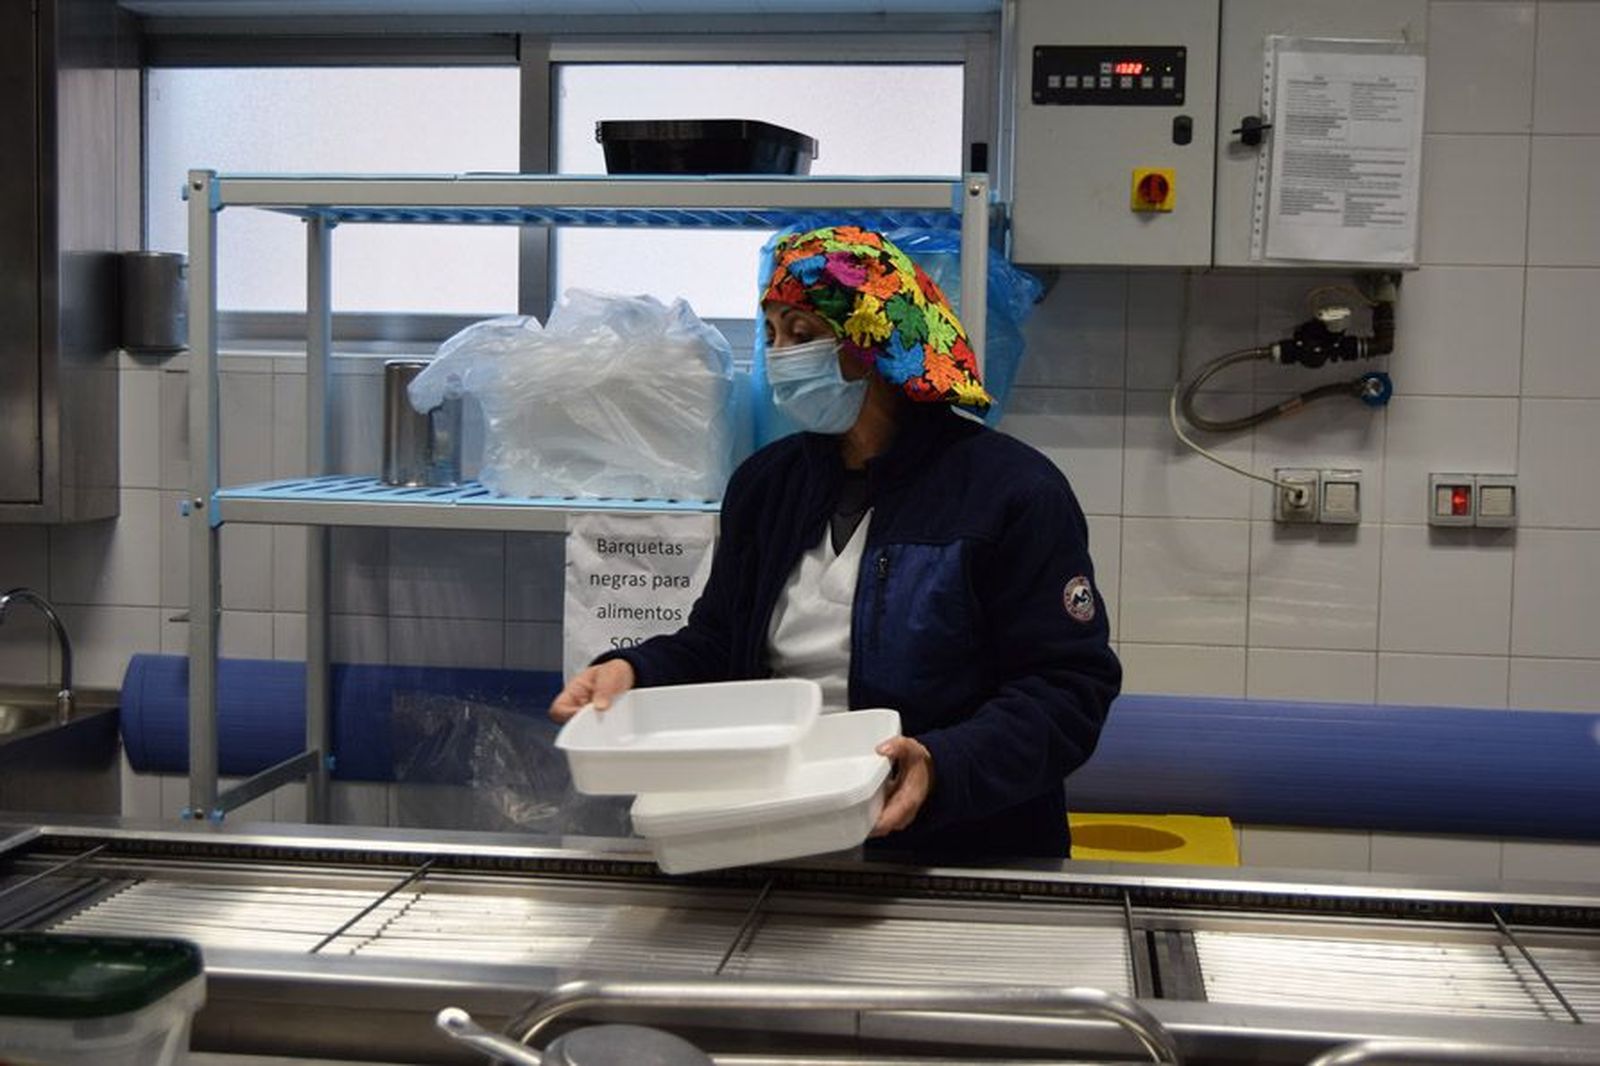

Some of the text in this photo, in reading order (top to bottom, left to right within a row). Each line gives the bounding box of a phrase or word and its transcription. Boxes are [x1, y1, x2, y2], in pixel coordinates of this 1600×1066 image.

[597, 538, 684, 557] Barquetas
[590, 573, 691, 591] negras para
[597, 603, 683, 621] alimentos
